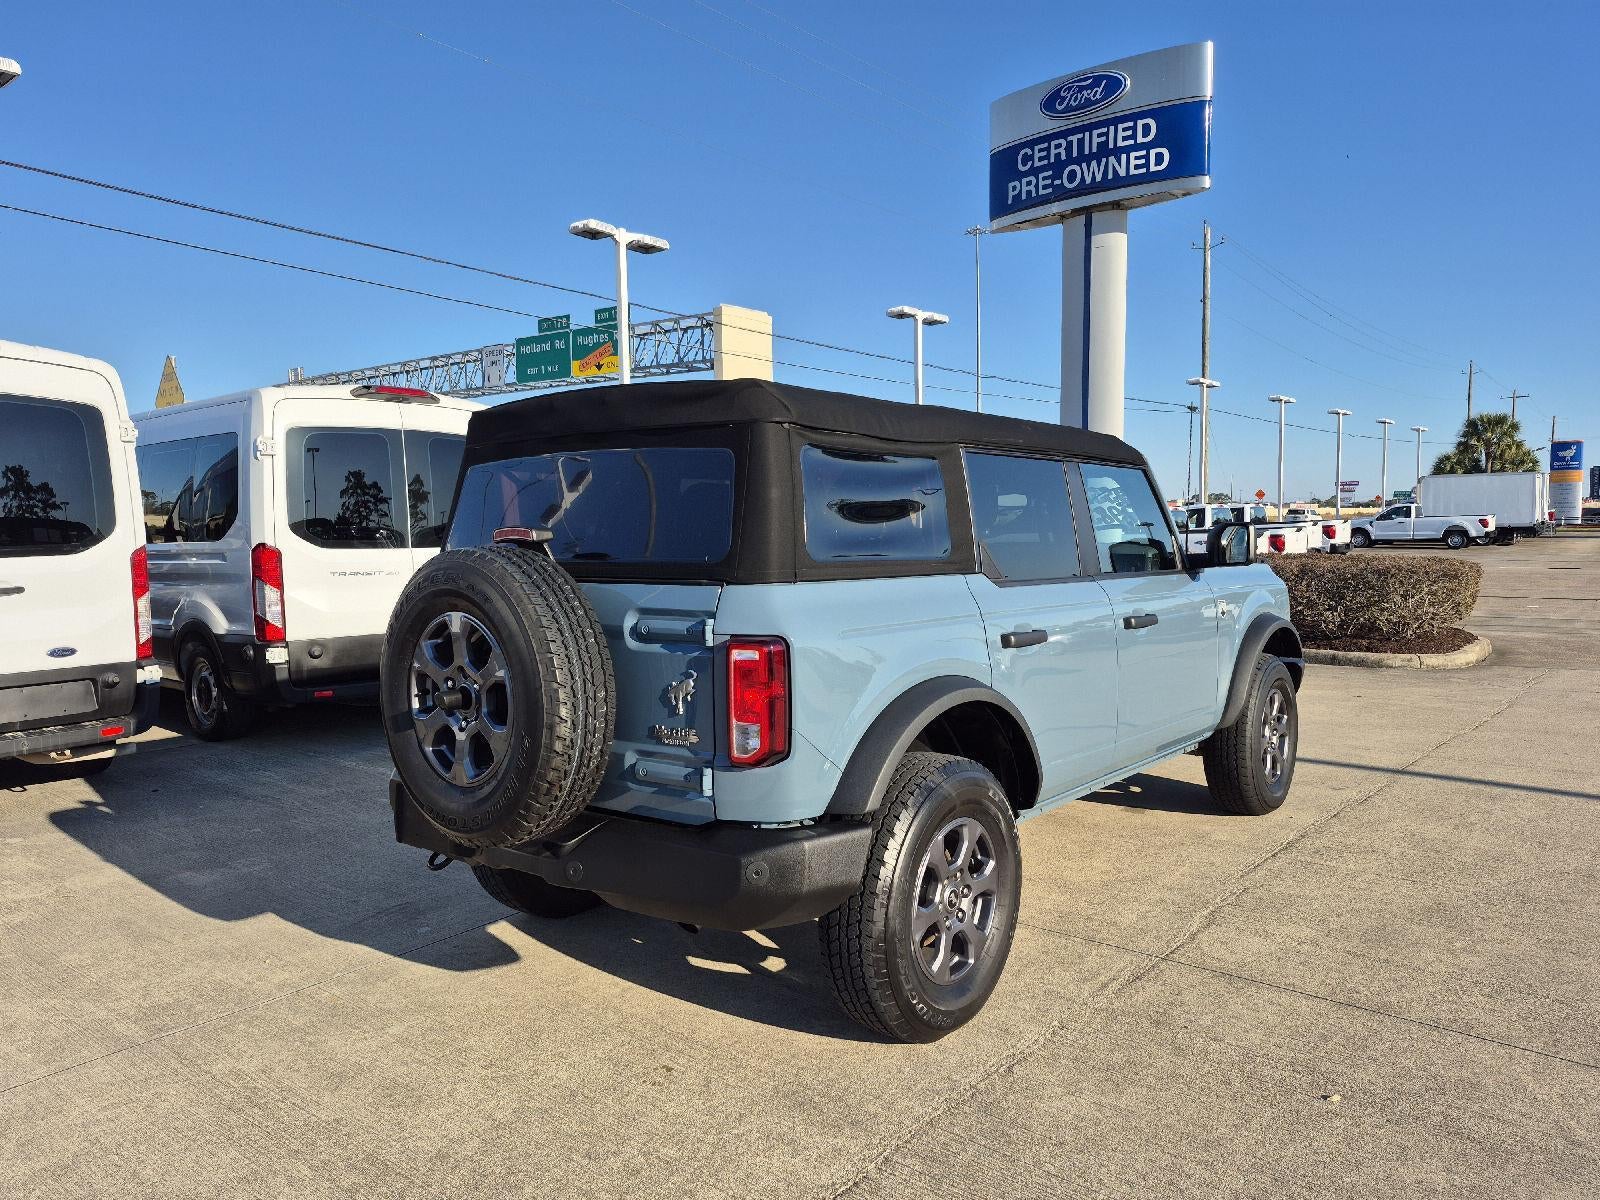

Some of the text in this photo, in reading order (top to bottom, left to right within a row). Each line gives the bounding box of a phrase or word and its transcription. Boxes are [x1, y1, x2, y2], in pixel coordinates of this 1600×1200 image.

[1017, 118, 1157, 172] CERTIFIED
[1007, 147, 1170, 205] PRE-OWNED
[597, 312, 609, 320] EXIT
[520, 339, 566, 354] Holland Rd
[577, 333, 609, 347] Hughes
[485, 350, 503, 358] SPEED
[527, 364, 559, 375] EXIT 1 MILE
